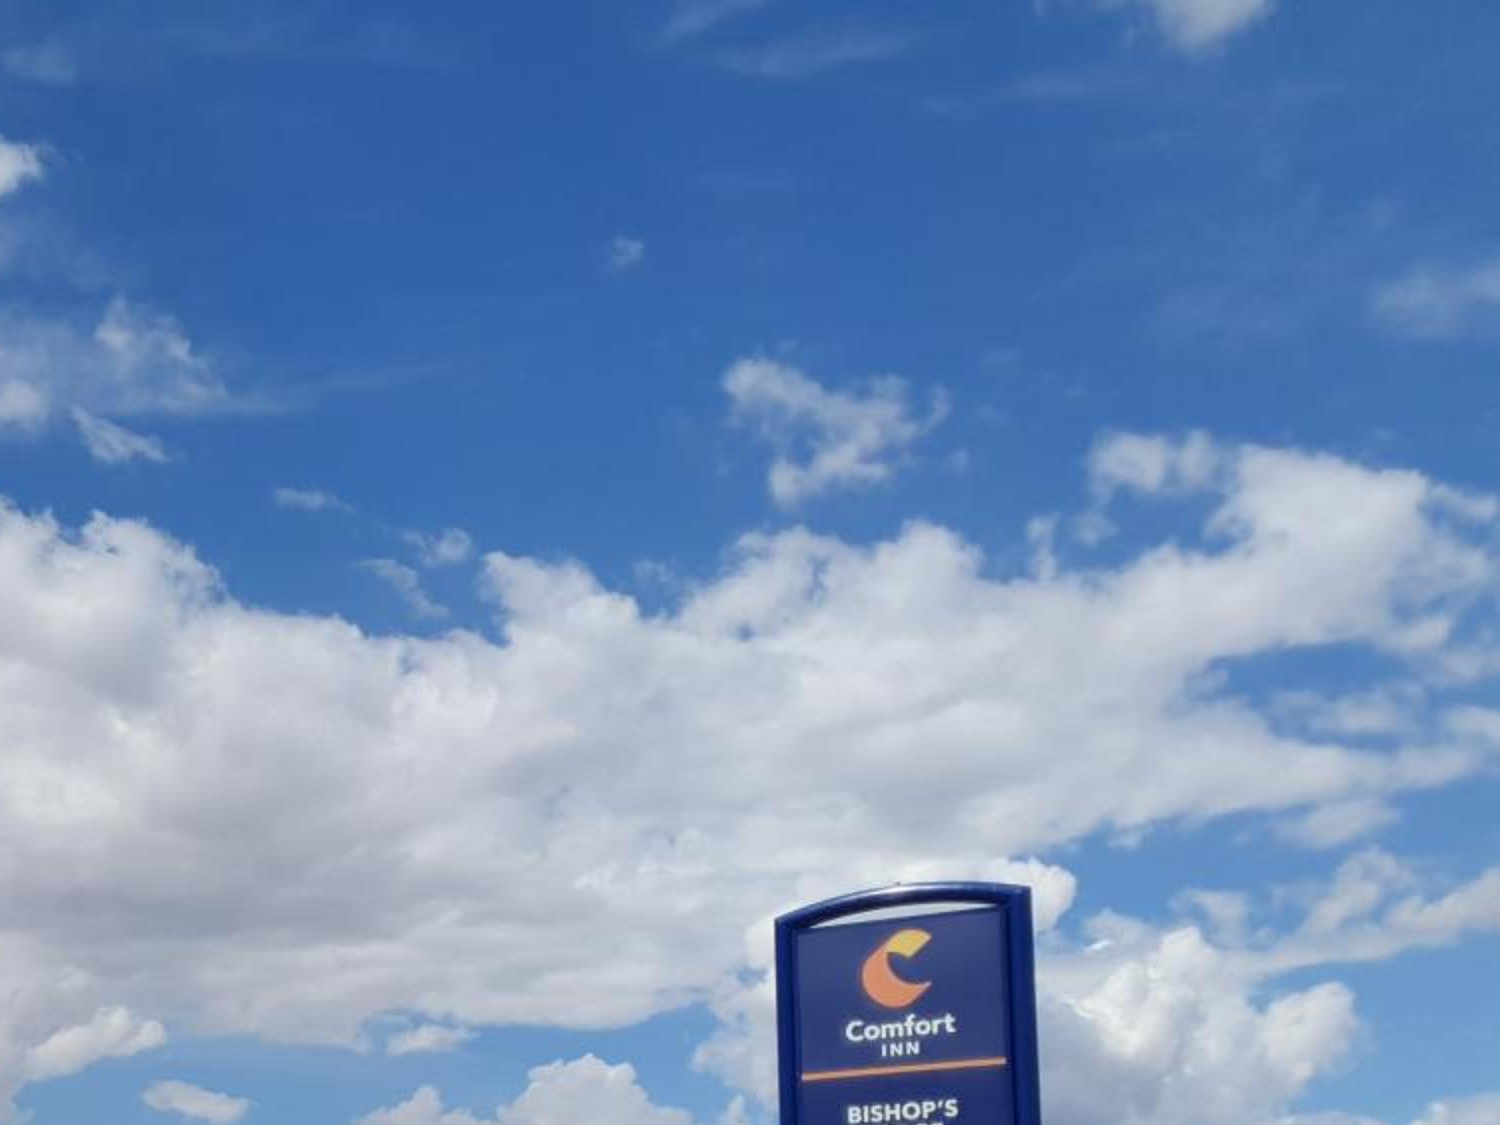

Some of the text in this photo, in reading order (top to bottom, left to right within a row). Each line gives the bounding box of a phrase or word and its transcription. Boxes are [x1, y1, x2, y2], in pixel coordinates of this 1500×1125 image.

[845, 1013, 957, 1042] Comfort
[881, 1041, 920, 1058] INN
[847, 1099, 959, 1124] BISHOP'S
